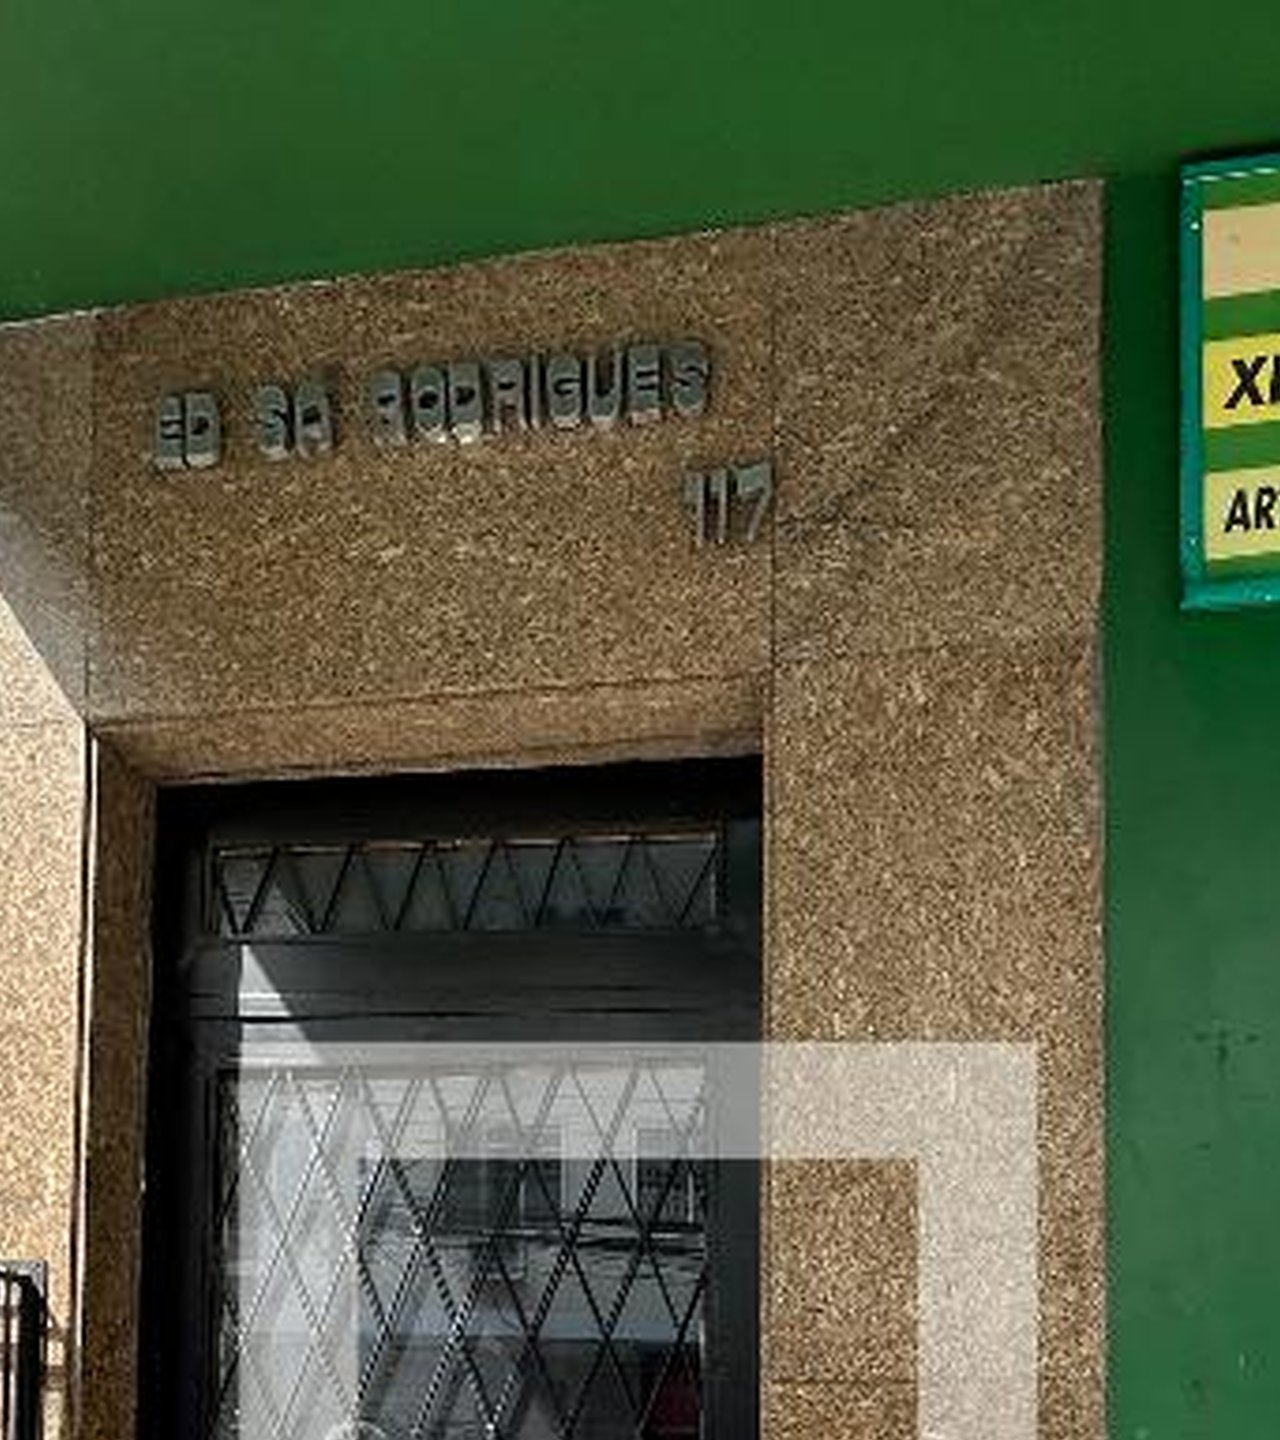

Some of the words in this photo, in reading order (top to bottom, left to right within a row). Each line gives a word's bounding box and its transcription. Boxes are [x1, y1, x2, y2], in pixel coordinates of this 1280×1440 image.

[156, 392, 219, 468] ED
[369, 340, 710, 446] RODRIGUES
[685, 460, 773, 545] 117
